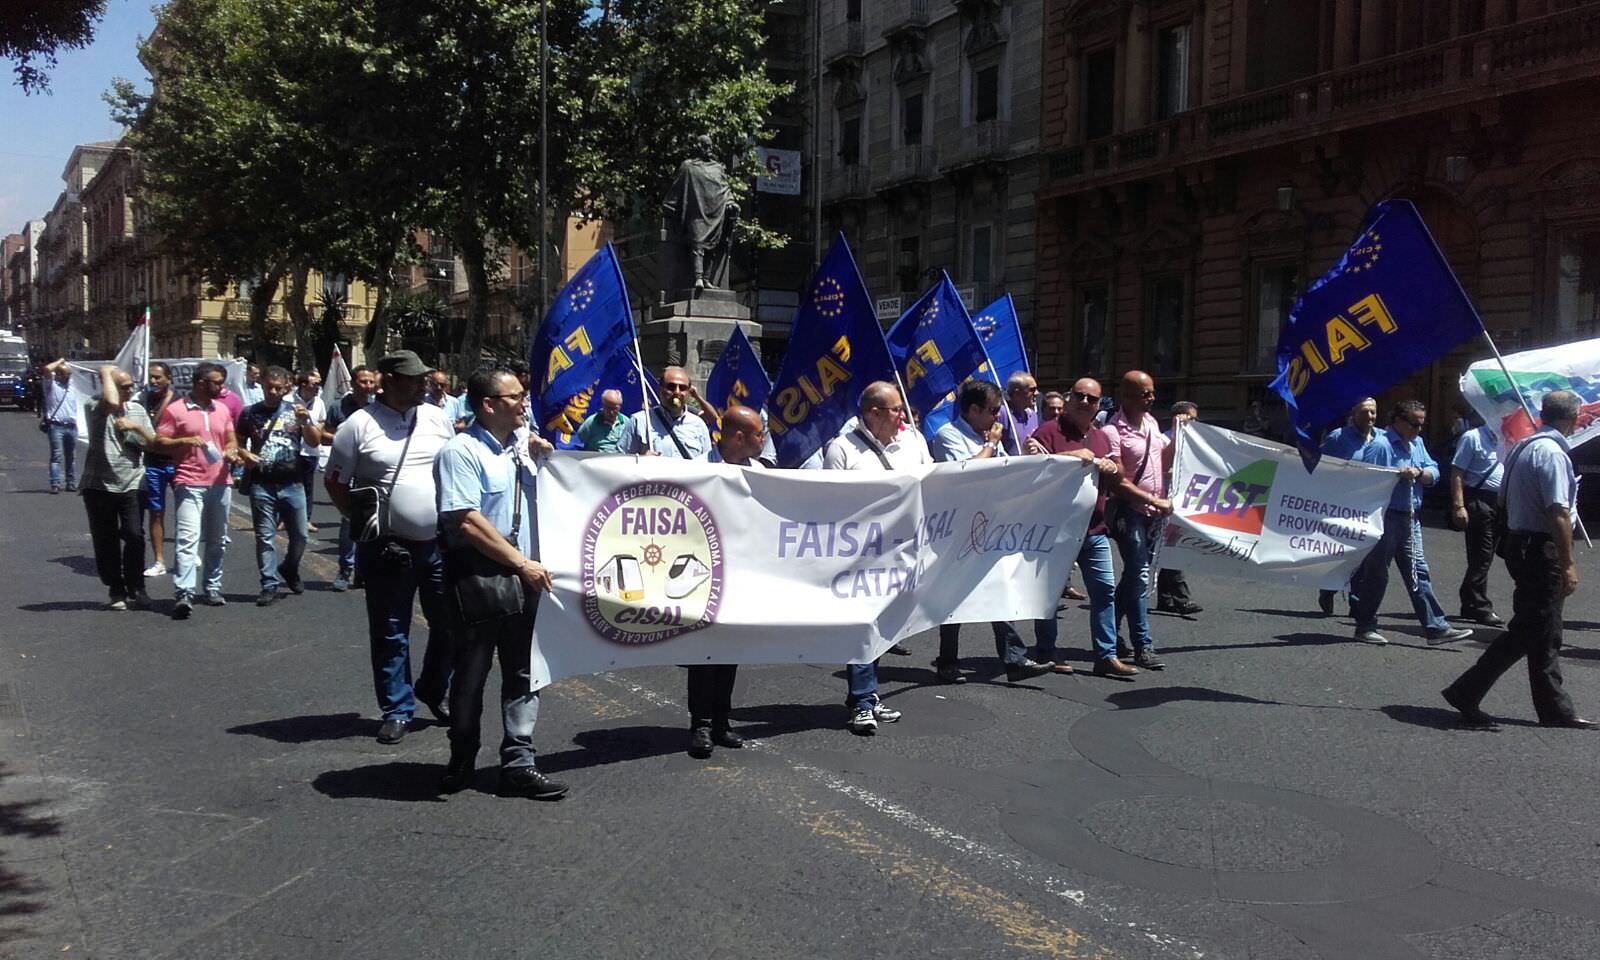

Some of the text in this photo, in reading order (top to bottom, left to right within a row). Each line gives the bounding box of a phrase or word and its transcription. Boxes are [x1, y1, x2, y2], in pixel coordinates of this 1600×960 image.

[1182, 473, 1270, 518] FAST
[1280, 495, 1369, 524] FEDERAZIONE
[614, 484, 692, 506] FEDERAZIONE
[694, 507, 721, 567] AUTONOMA
[621, 508, 688, 535] FAISA
[1278, 514, 1367, 541] PROVINCIALE
[778, 520, 884, 559] FAISA
[1289, 535, 1346, 557] CATANIA
